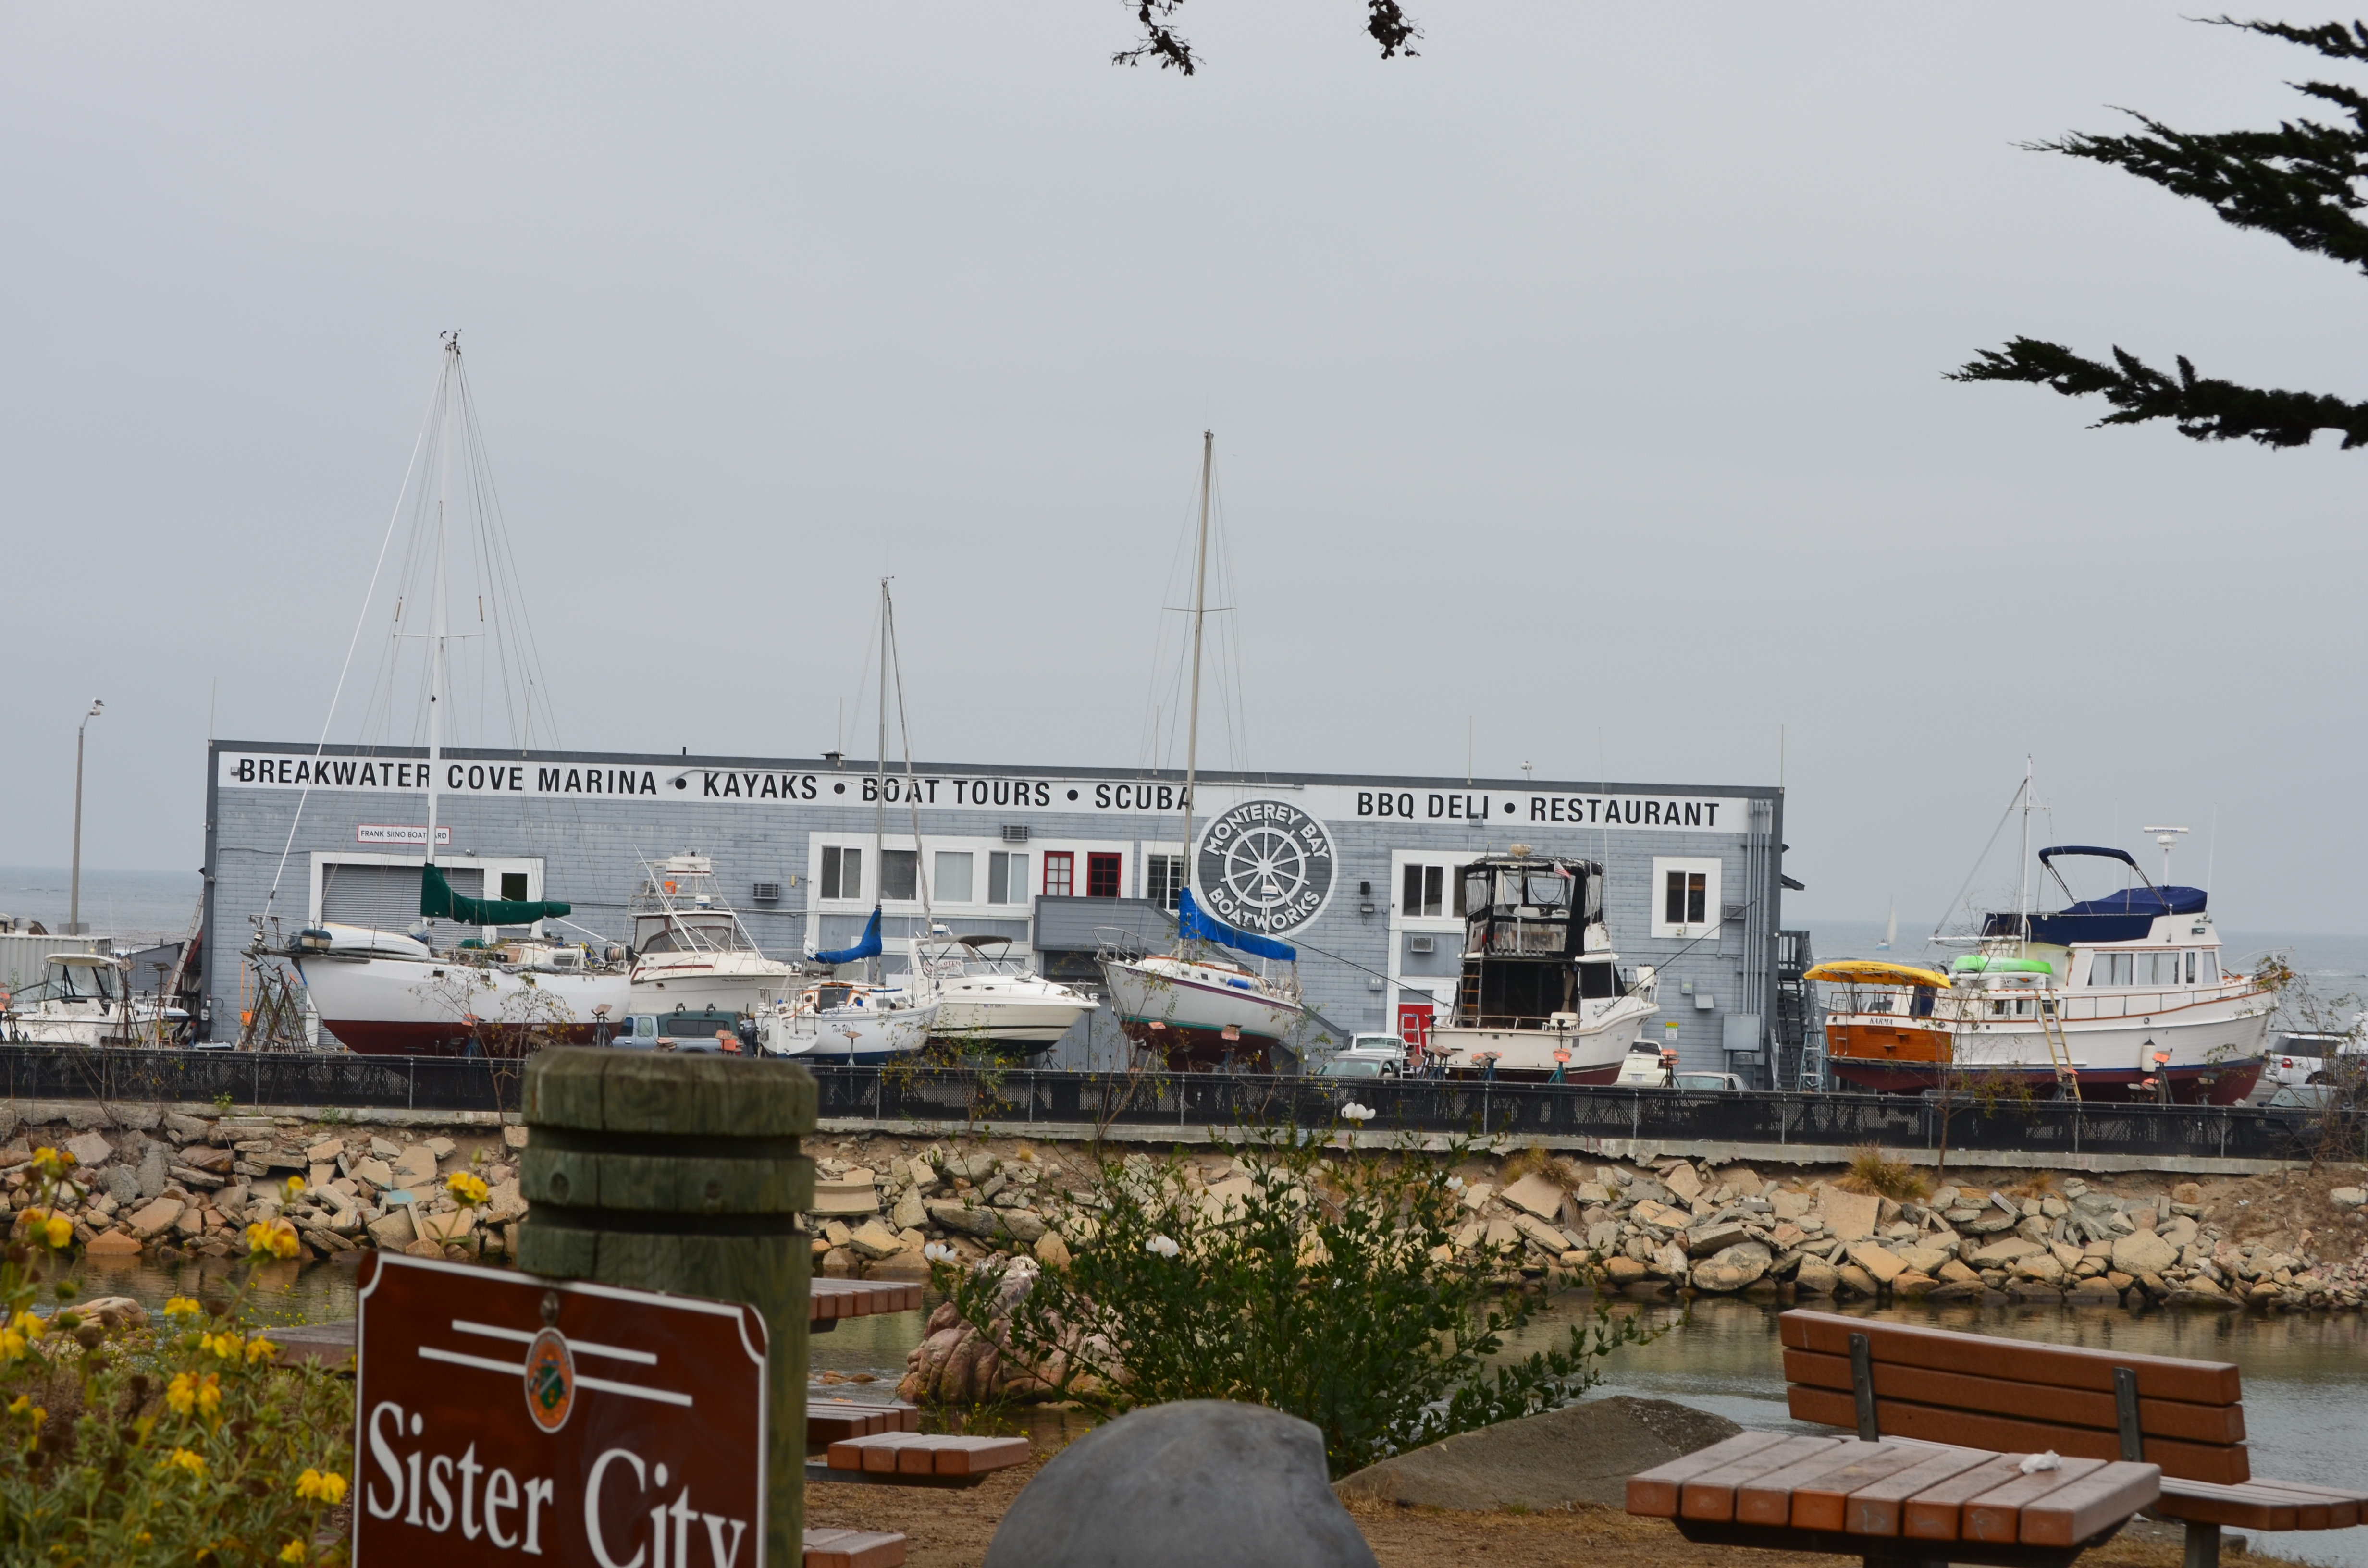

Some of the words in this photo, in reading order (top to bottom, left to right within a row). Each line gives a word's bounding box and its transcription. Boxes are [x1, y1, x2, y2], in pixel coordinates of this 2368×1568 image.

[239, 758, 430, 788] BREAKWATER
[448, 765, 523, 791] COVE
[538, 768, 657, 795] MARINA
[704, 772, 817, 799] KAYAKS
[863, 778, 940, 803] BOAT
[953, 780, 1050, 806] TOURS
[1095, 784, 1194, 810] SCUBA
[1358, 792, 1414, 819] BBQ
[1428, 794, 1488, 819] DELI
[1531, 797, 1719, 826] RESTAURANT
[1204, 804, 1302, 855] MONTEREY
[1300, 823, 1329, 858] BAY
[1209, 888, 1320, 930] BOATWORKS
[831, 1024, 841, 1033] Ten
[1869, 1017, 1893, 1026] KARMA
[367, 1401, 553, 1555] Sister
